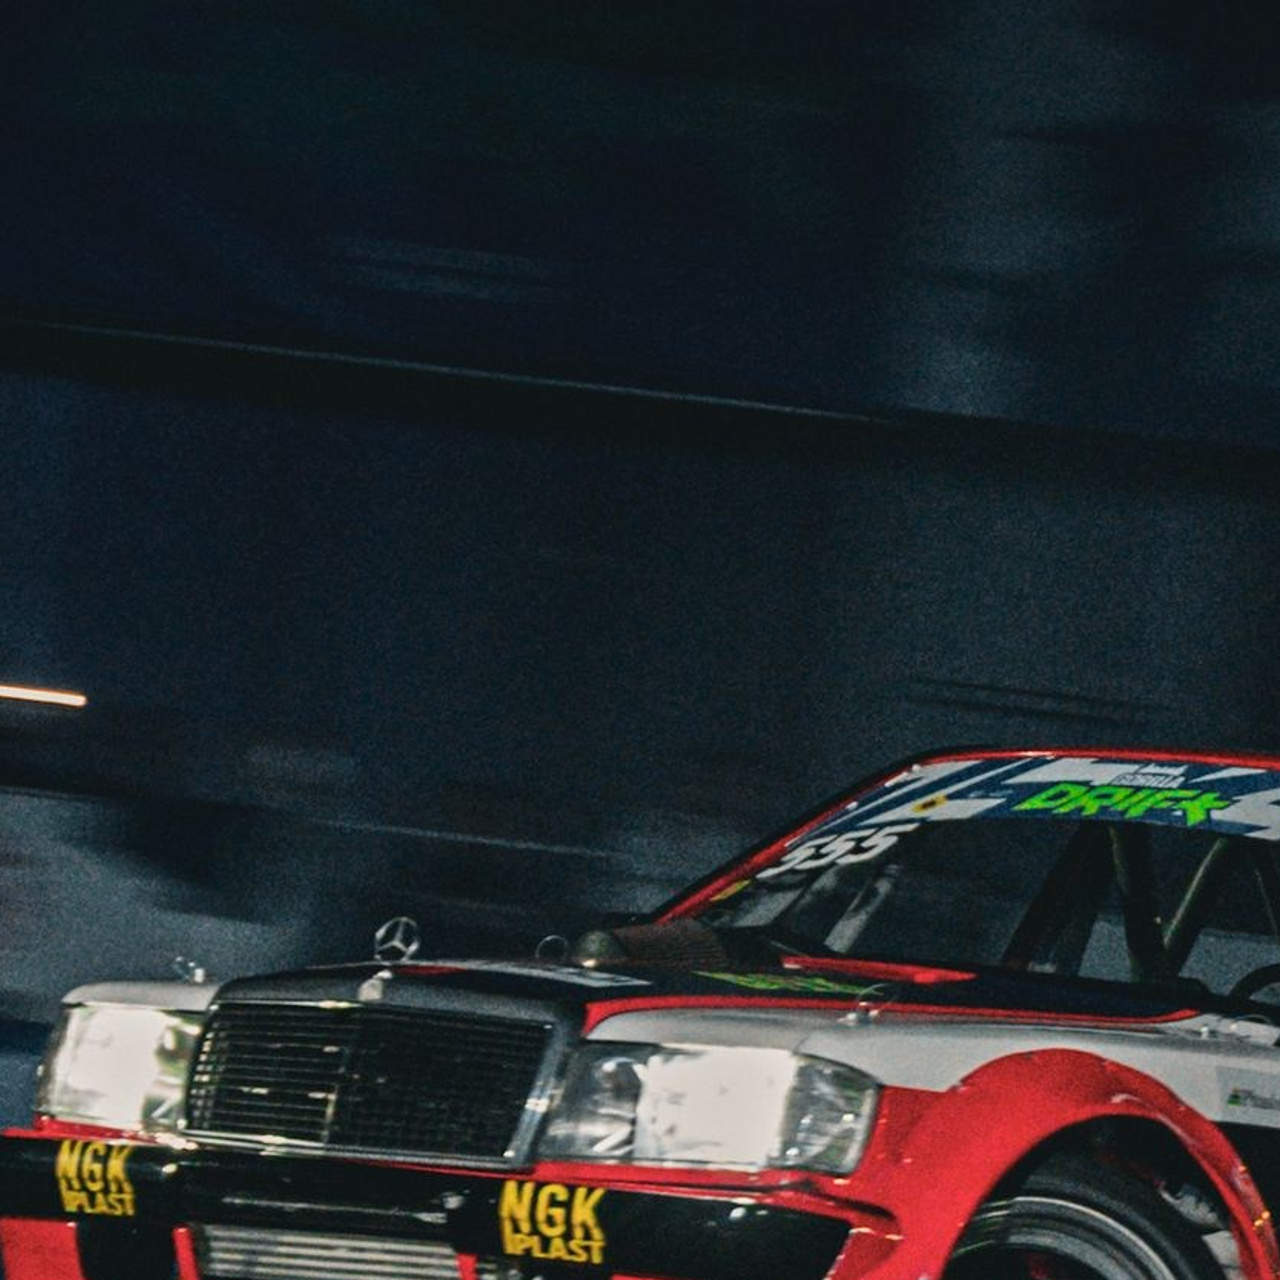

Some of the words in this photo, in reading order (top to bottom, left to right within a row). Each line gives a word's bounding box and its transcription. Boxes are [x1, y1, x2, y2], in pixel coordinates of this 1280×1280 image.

[1010, 783, 1230, 828] DRIFT
[755, 822, 922, 880] 555
[55, 1138, 135, 1194] NGK
[500, 1179, 607, 1241] NGK
